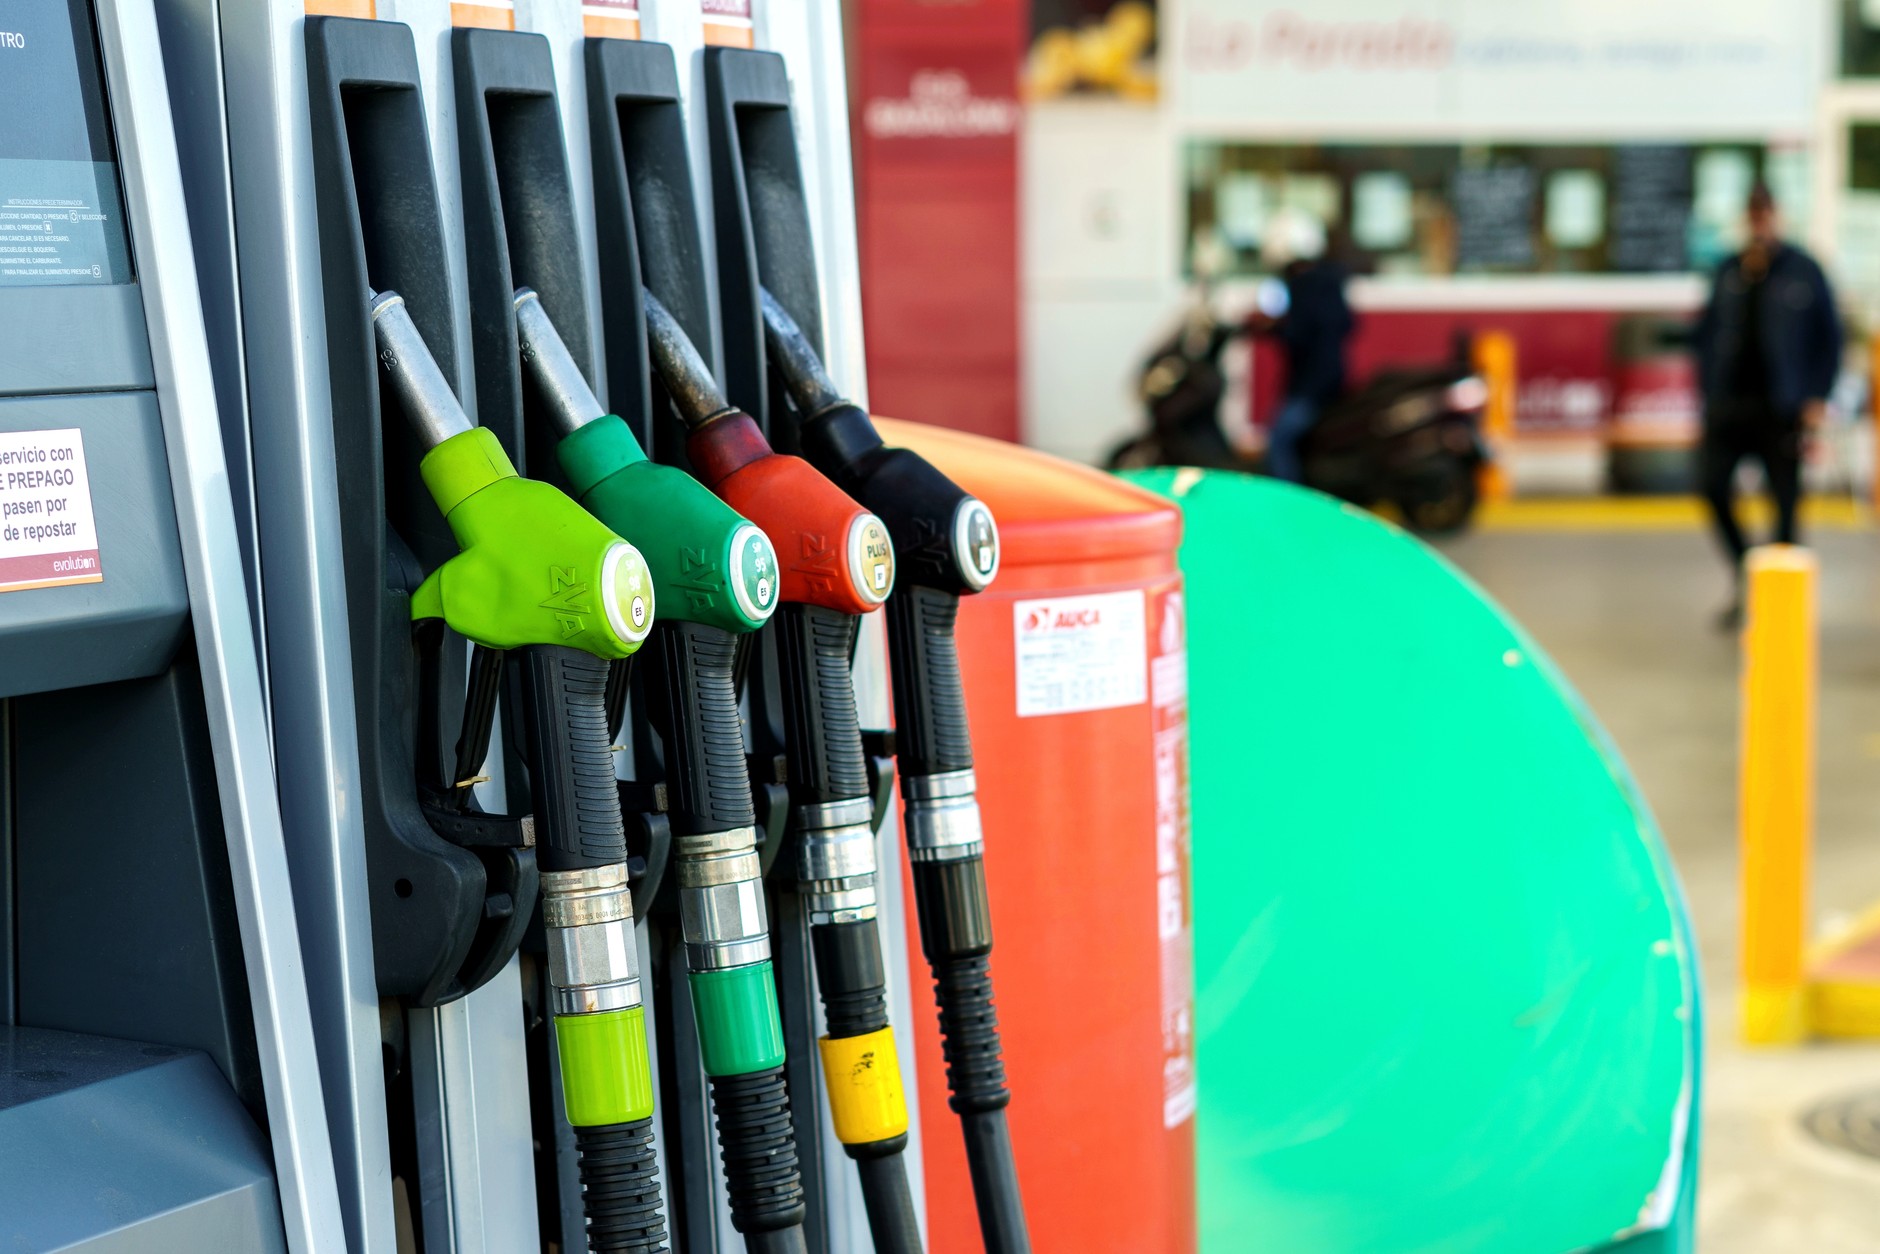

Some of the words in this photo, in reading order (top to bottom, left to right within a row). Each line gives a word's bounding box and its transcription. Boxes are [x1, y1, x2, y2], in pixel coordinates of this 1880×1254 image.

[50, 447, 74, 461] con
[7, 468, 74, 490] PREPAGO
[3, 500, 43, 520] pasen
[46, 498, 67, 516] por
[4, 523, 20, 541] de
[23, 520, 77, 542] repostar
[867, 543, 887, 558] PLUS
[754, 557, 767, 572] 95
[635, 606, 643, 617] E5
